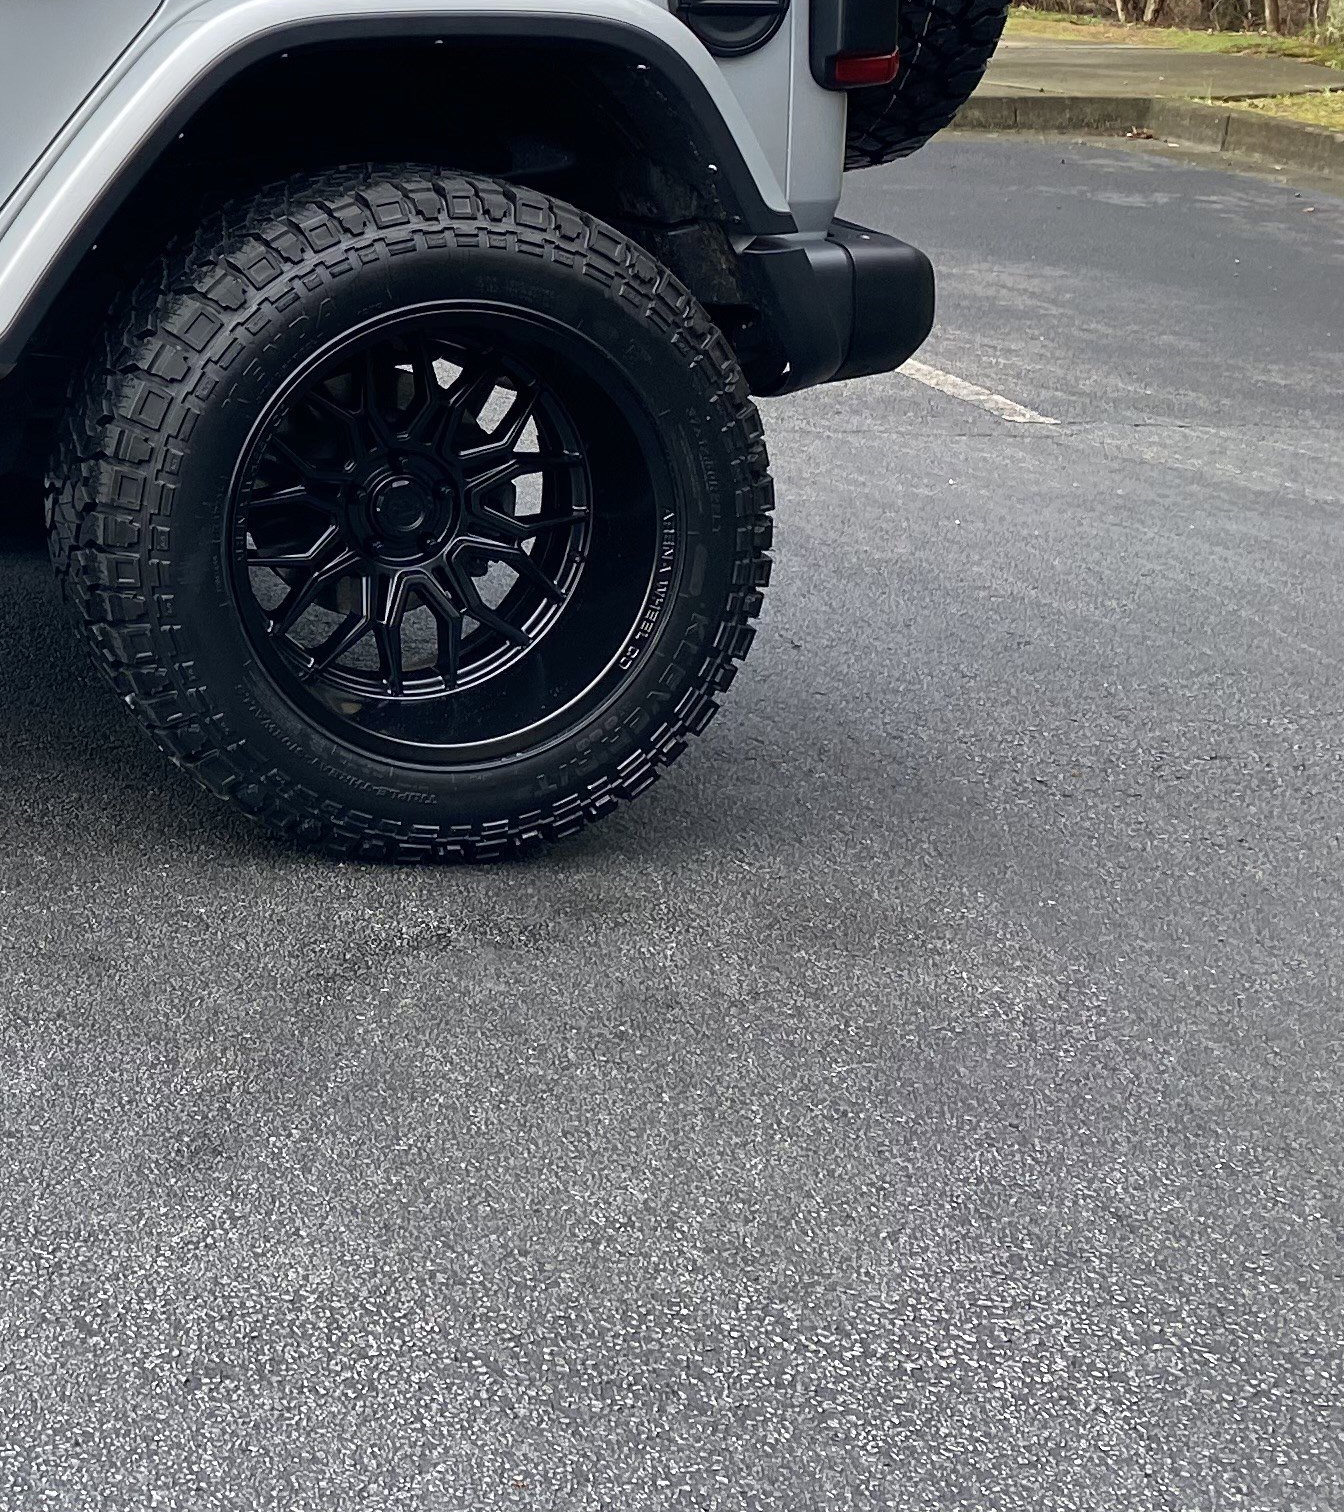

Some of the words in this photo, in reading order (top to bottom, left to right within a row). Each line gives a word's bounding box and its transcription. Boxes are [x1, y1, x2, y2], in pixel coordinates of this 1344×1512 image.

[659, 509, 675, 573] ARENA
[634, 580, 669, 639] WHEEL
[618, 645, 640, 670] CO
